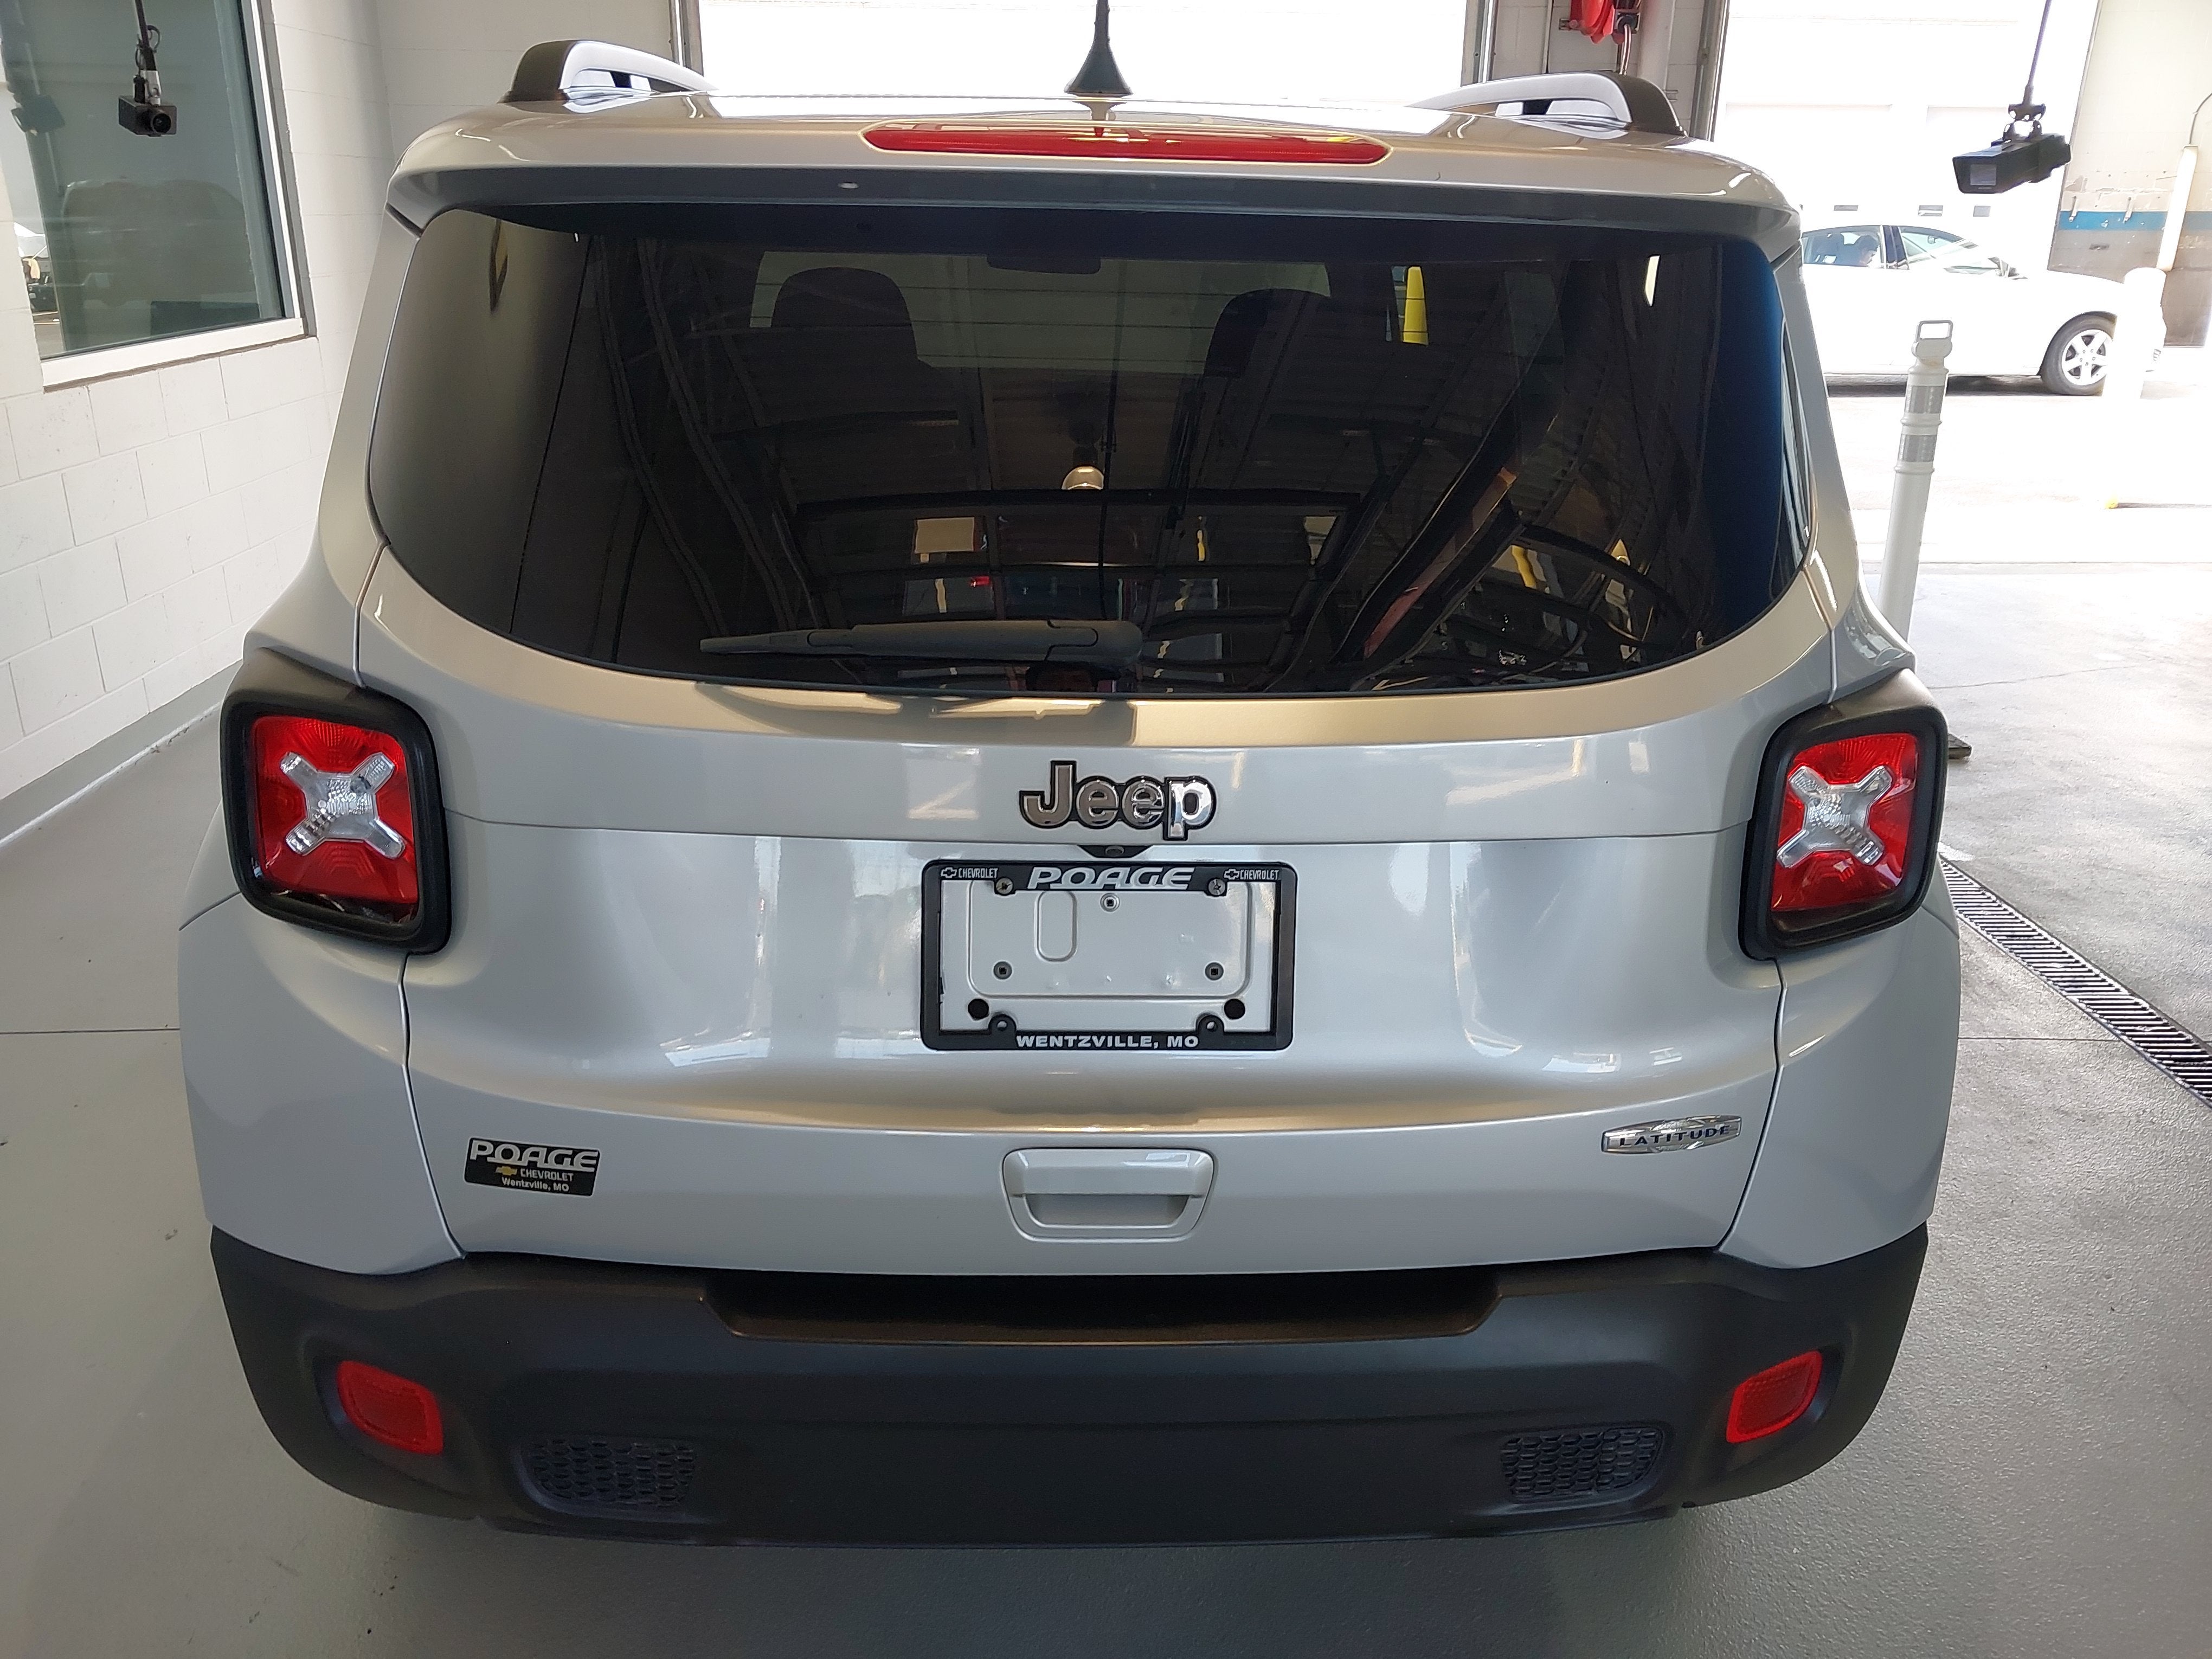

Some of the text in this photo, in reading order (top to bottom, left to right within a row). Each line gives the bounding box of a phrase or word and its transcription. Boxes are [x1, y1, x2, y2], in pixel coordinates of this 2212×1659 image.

[1019, 760, 1216, 840] Jeep
[957, 867, 998, 878] CHEVROLET
[1027, 867, 1195, 889] POAGE
[1239, 869, 1279, 880] CHEVROLET
[1016, 1036, 1199, 1049] WENTZVILLE, MO
[1619, 1124, 1731, 1148] LATITUDE
[470, 1139, 599, 1172] POAGE
[520, 1168, 574, 1182] CHEVROLET
[501, 1177, 569, 1192] Wentzville, MO
